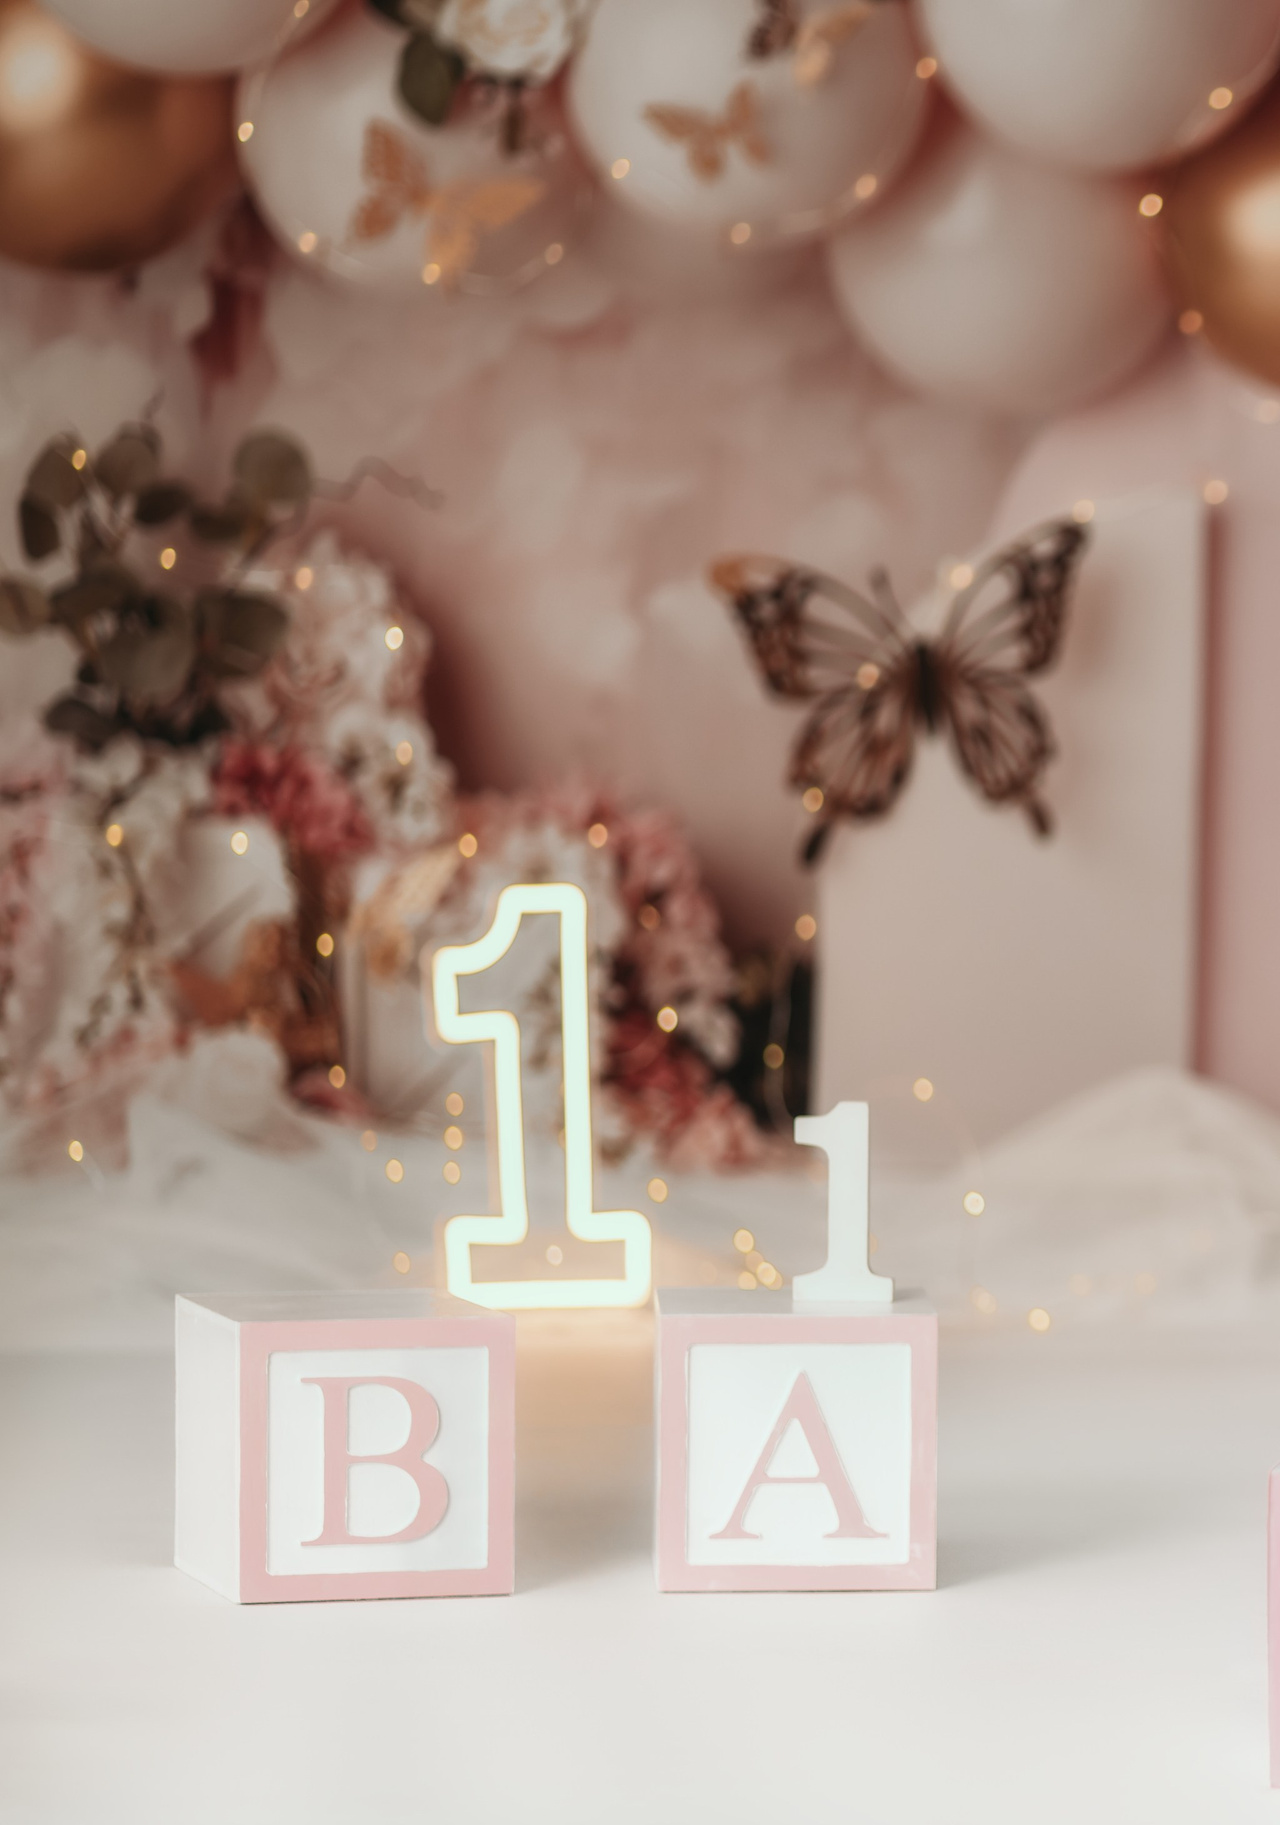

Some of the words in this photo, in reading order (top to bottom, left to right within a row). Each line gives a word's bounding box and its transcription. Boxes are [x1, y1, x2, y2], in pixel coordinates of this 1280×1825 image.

[432, 883, 652, 1309] 1
[792, 1101, 894, 1303] 1
[300, 1376, 450, 1546] B
[708, 1370, 890, 1539] A
